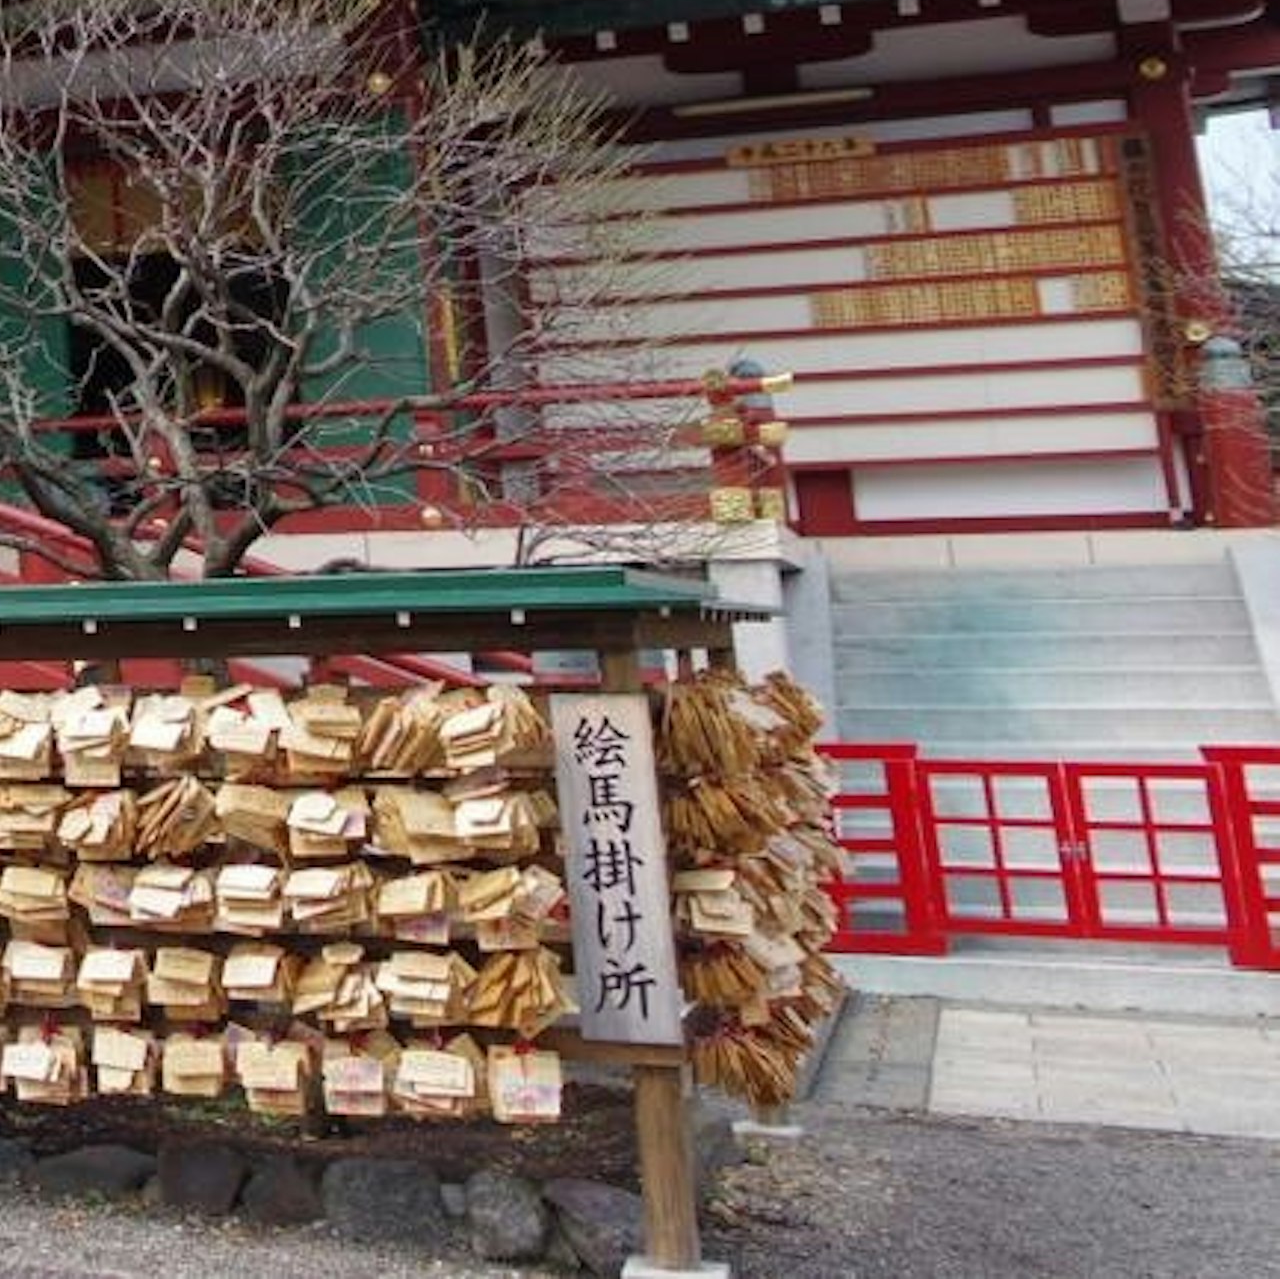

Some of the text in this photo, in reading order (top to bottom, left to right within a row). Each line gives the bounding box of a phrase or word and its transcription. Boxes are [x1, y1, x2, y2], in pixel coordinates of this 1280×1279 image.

[573, 716, 656, 1021] 絵馬掛け所
